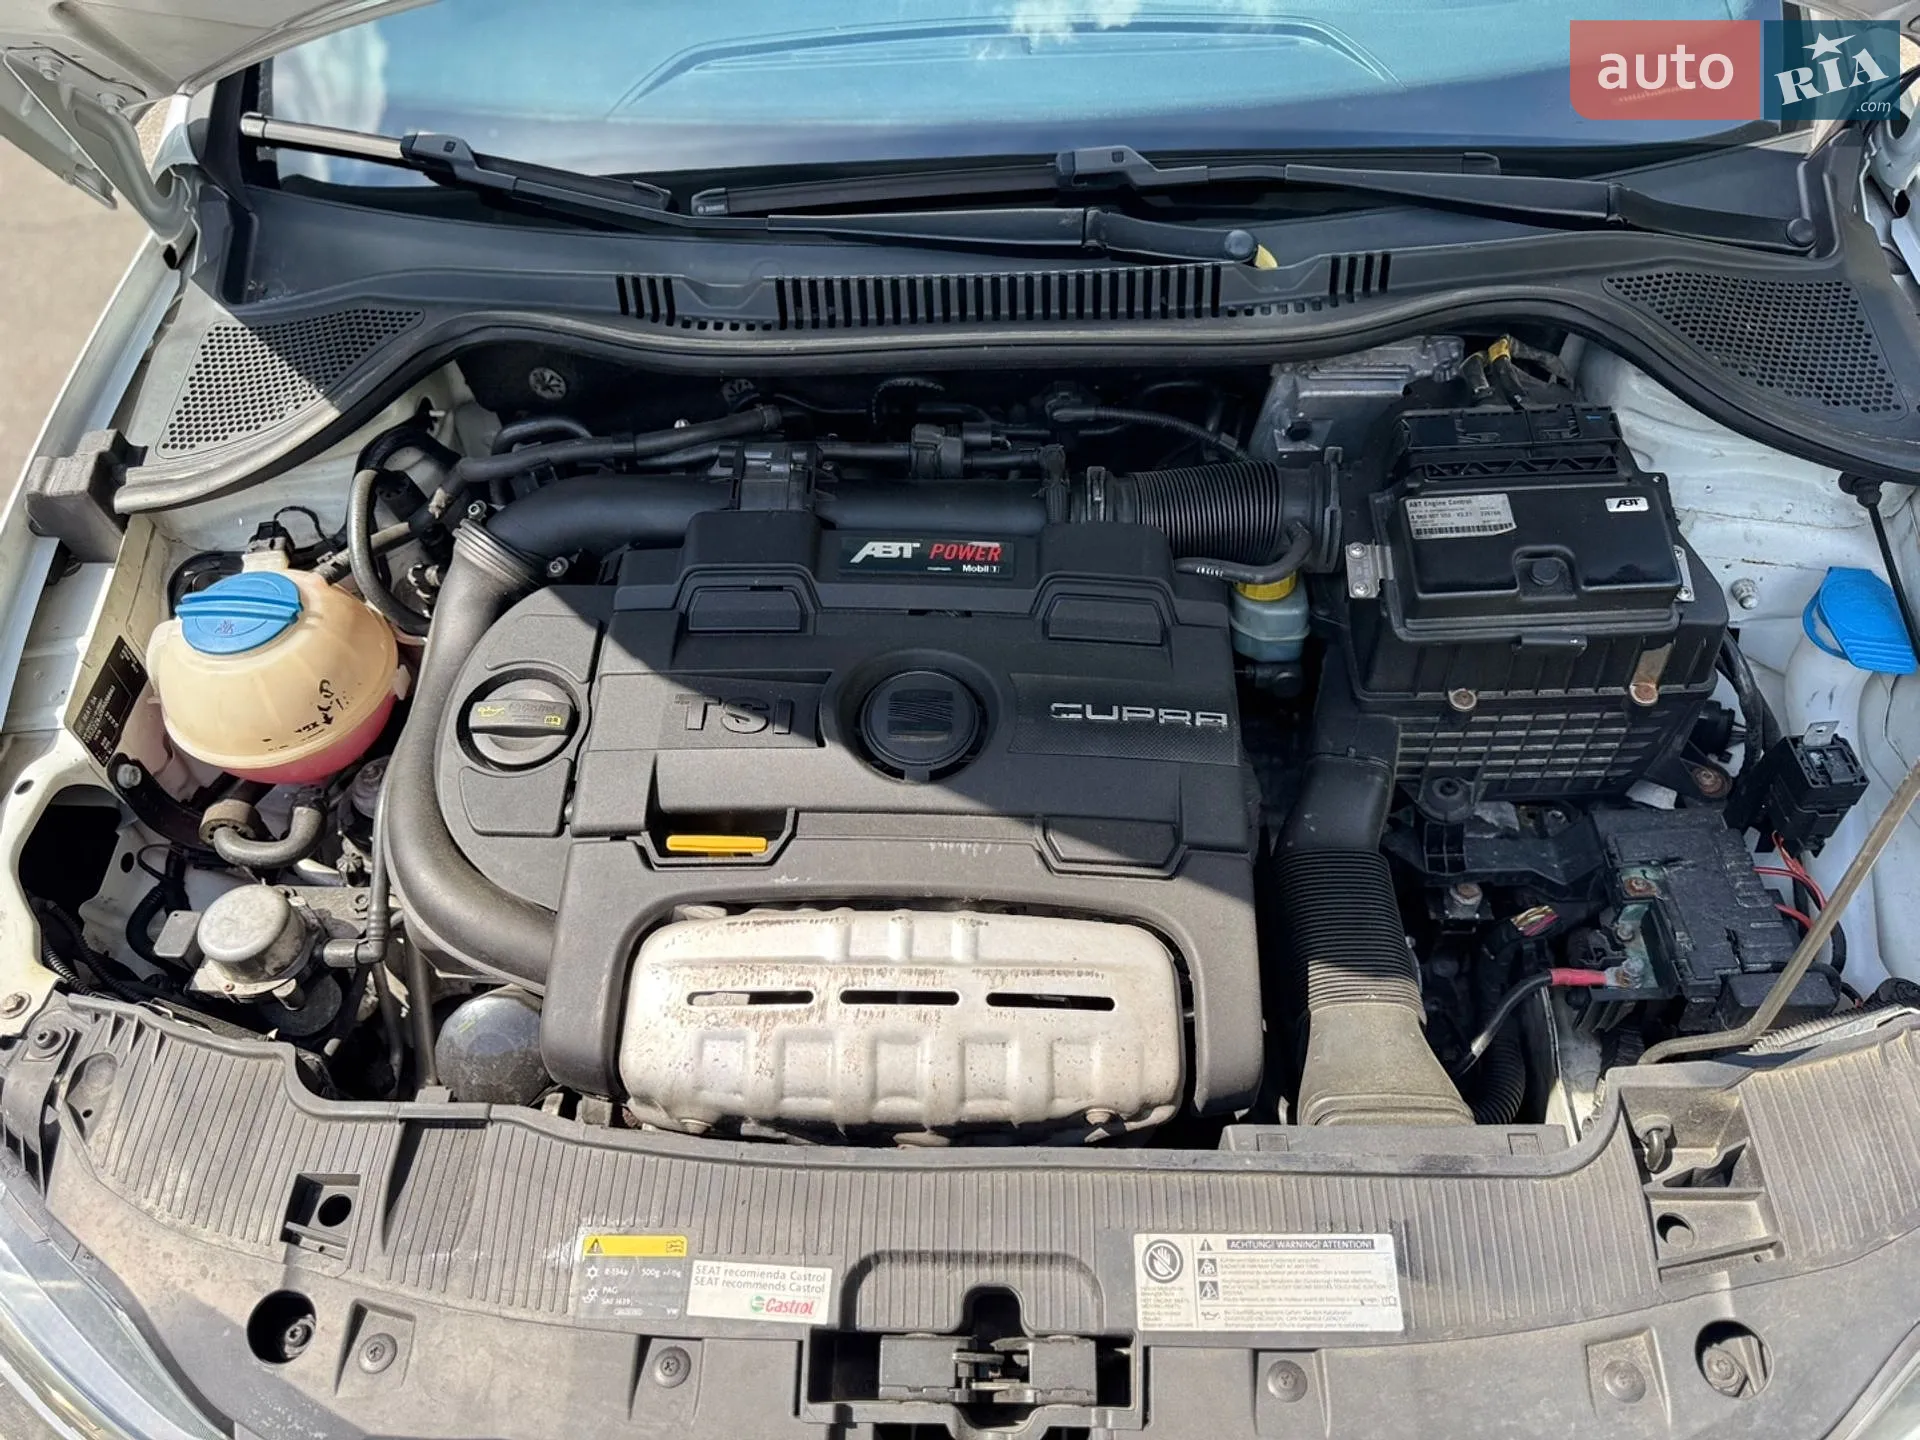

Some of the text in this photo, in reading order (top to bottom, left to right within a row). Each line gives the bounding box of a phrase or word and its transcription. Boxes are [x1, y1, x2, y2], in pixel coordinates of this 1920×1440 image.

[1616, 498, 1640, 509] ABT
[850, 540, 1002, 564] ABT POWER
[962, 564, 989, 573] Mobil
[675, 693, 794, 734] TSI
[1050, 702, 1229, 728] CUPRA
[1230, 1240, 1373, 1250] ACHTUNG! WARNING! ATTENTION!
[696, 1265, 827, 1283] SEAT recomienda Castrol
[693, 1276, 825, 1294] SEAT recommends Castrol
[765, 1297, 815, 1315] Castrol
